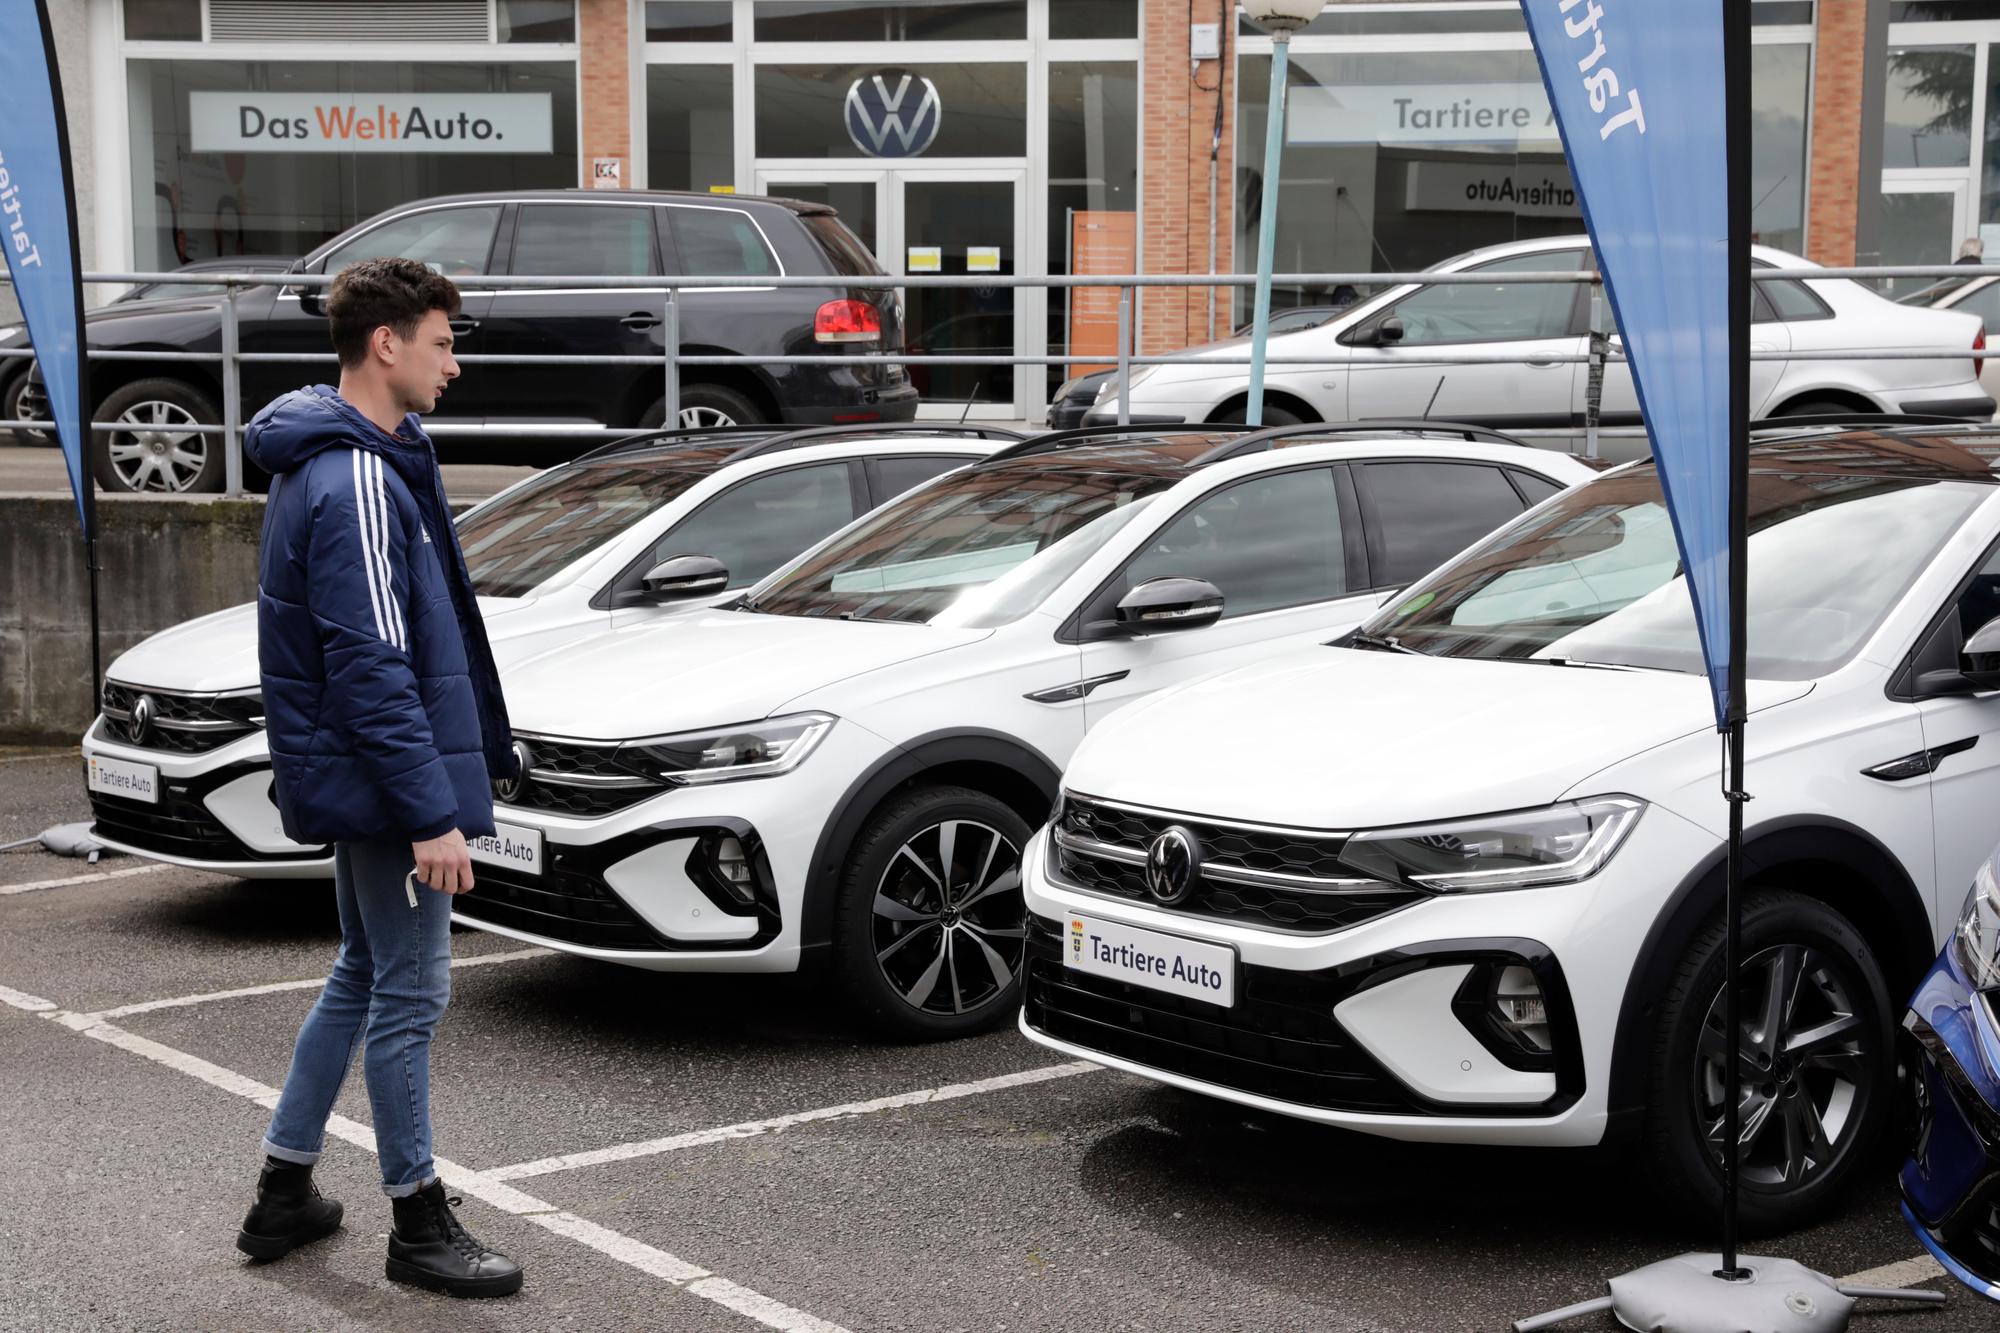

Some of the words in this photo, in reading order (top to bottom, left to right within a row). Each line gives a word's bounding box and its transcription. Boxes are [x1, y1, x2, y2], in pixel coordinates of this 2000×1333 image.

[239, 105, 309, 139] Das
[314, 105, 503, 140] WeltAuto.
[1393, 98, 1531, 129] Tartiere
[99, 767, 130, 790] Tartiere
[131, 774, 151, 793] Auto
[465, 837, 502, 855] artiere
[504, 837, 533, 862] Auto
[1090, 934, 1167, 977] Tartiere
[1171, 955, 1222, 991] Auto
